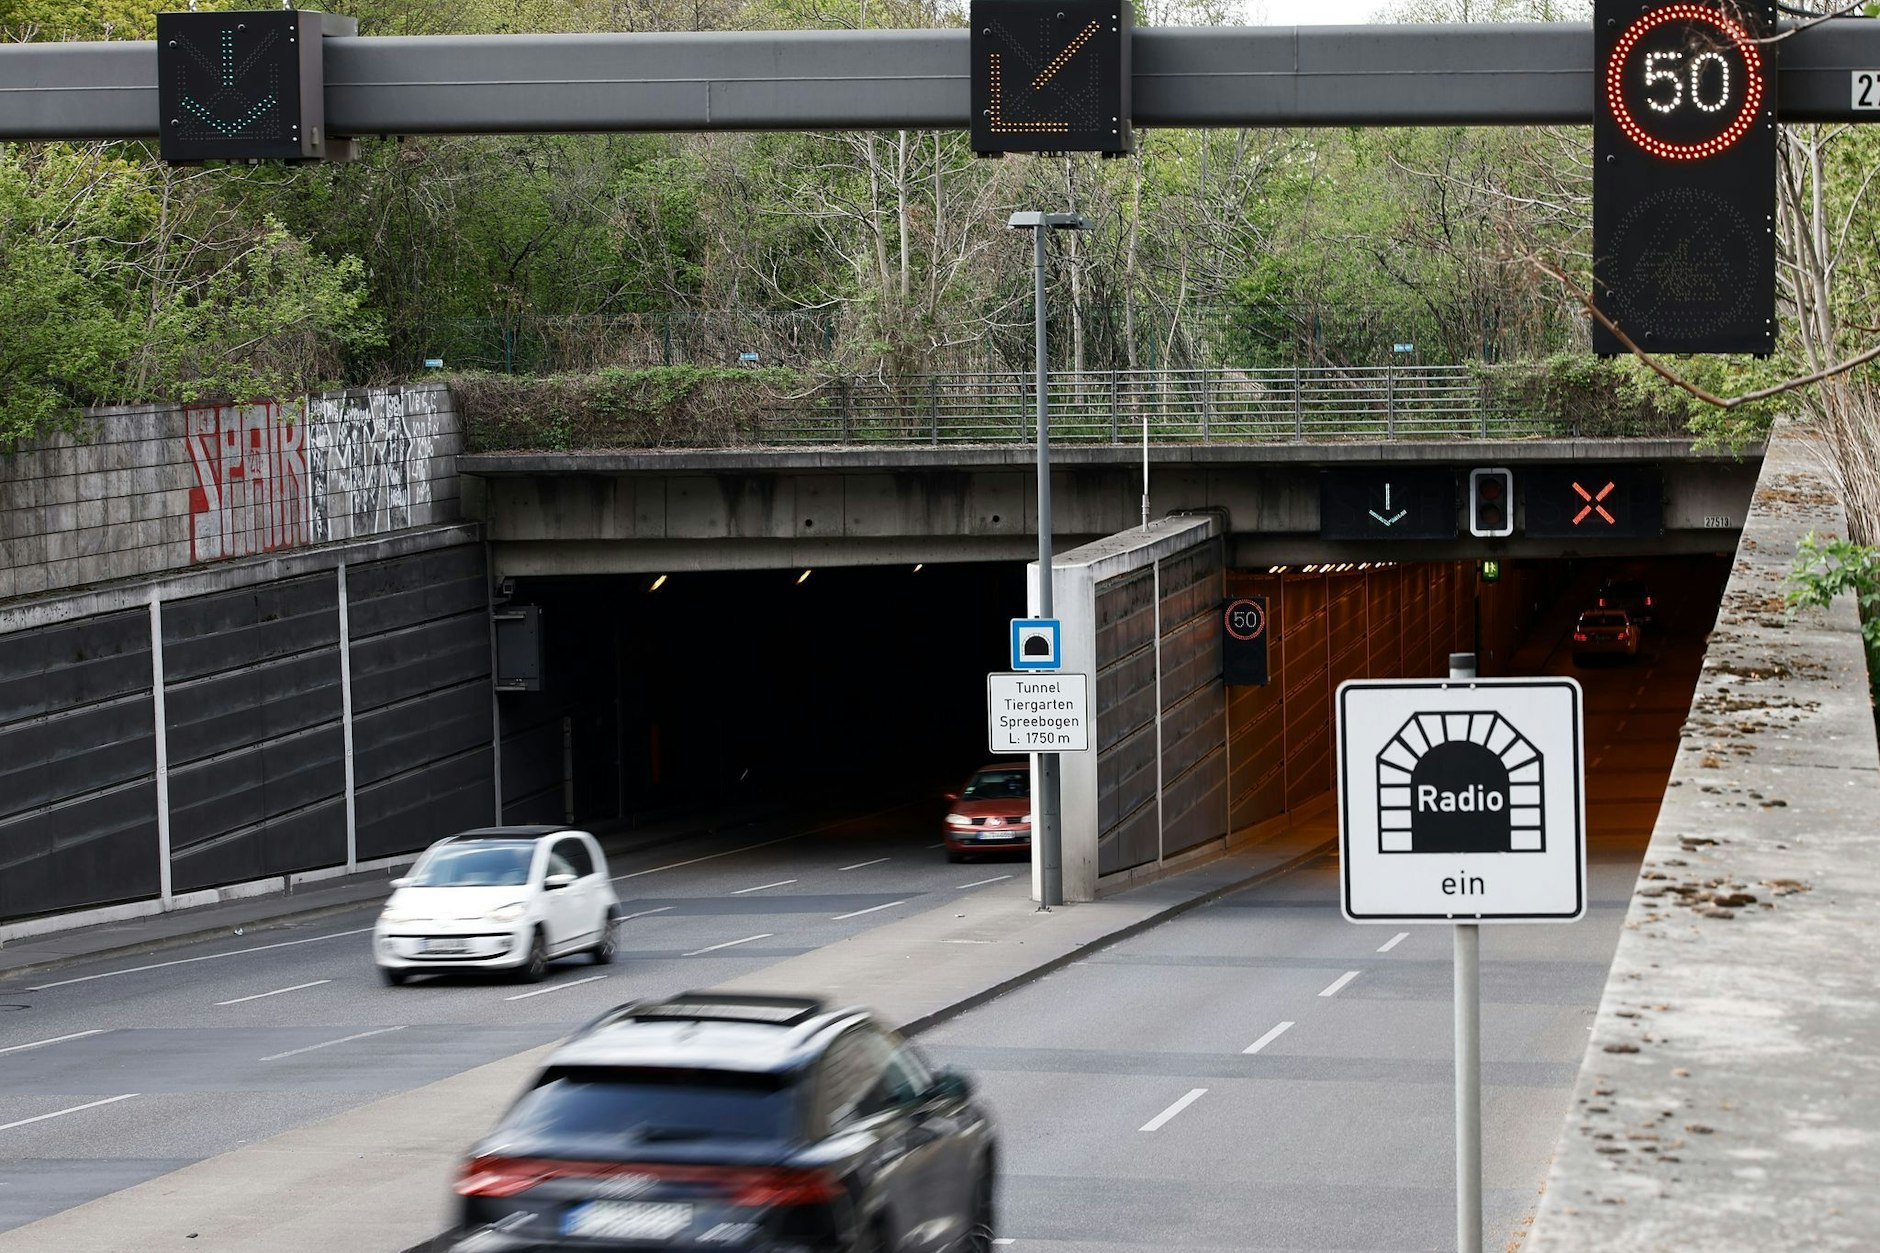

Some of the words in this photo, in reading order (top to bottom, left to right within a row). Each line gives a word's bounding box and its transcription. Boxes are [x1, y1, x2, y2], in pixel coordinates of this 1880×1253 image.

[1645, 52, 1730, 113] 50
[1858, 73, 1880, 107] 2
[1233, 611, 1257, 628] 50
[1016, 682, 1061, 693] Tunnel
[1004, 699, 1073, 712] Tiergarten
[1000, 715, 1079, 730] Spreebogen
[1026, 732, 1055, 744] 1750
[1058, 733, 1070, 744] m
[1417, 784, 1504, 812] Radio
[1441, 870, 1485, 895] ein
